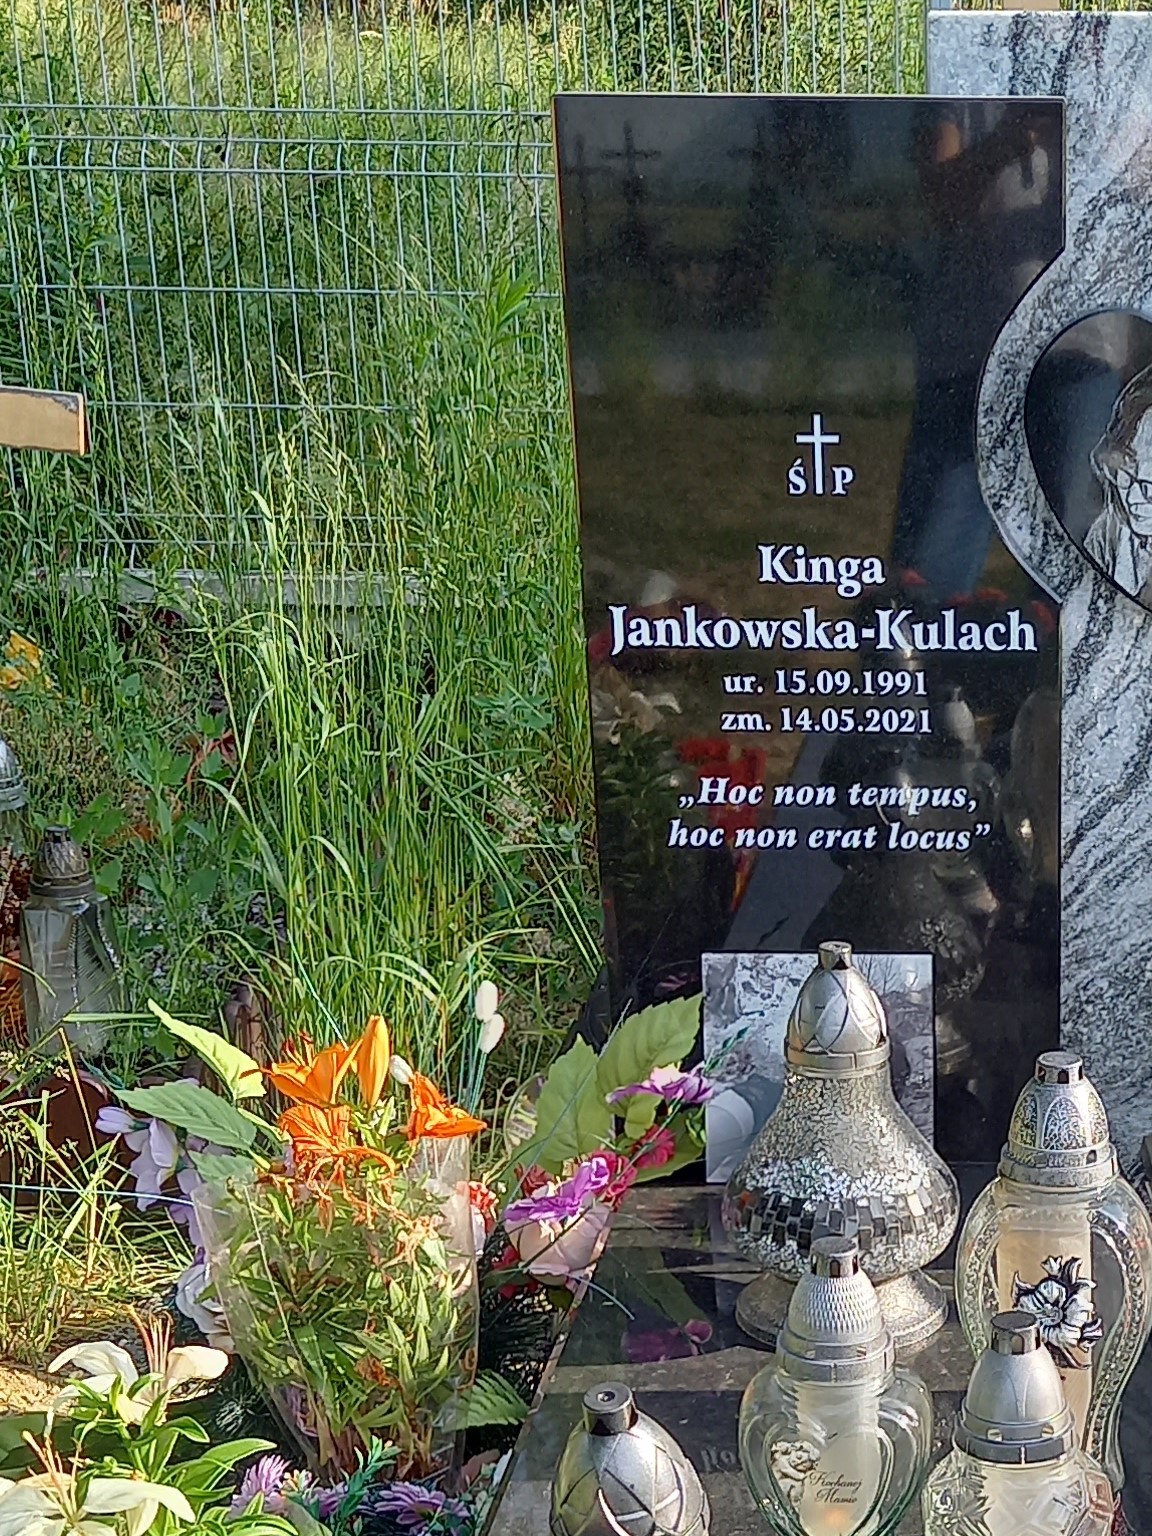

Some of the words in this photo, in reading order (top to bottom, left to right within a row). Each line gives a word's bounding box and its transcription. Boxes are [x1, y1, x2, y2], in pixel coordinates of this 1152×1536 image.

[758, 545, 886, 598] Kinga
[608, 605, 1038, 655] Jankowska-Kulach
[723, 675, 764, 694] ur.
[775, 669, 927, 695] 15.09.1991
[721, 713, 771, 732] zm.
[780, 708, 932, 733] 14.05.2021
[677, 776, 764, 810] „Hoc
[774, 786, 836, 807] non
[848, 784, 978, 816] tempus,
[668, 819, 724, 848] hoc
[735, 828, 797, 849] non
[808, 825, 878, 849] erat
[888, 821, 991, 851] locus”
